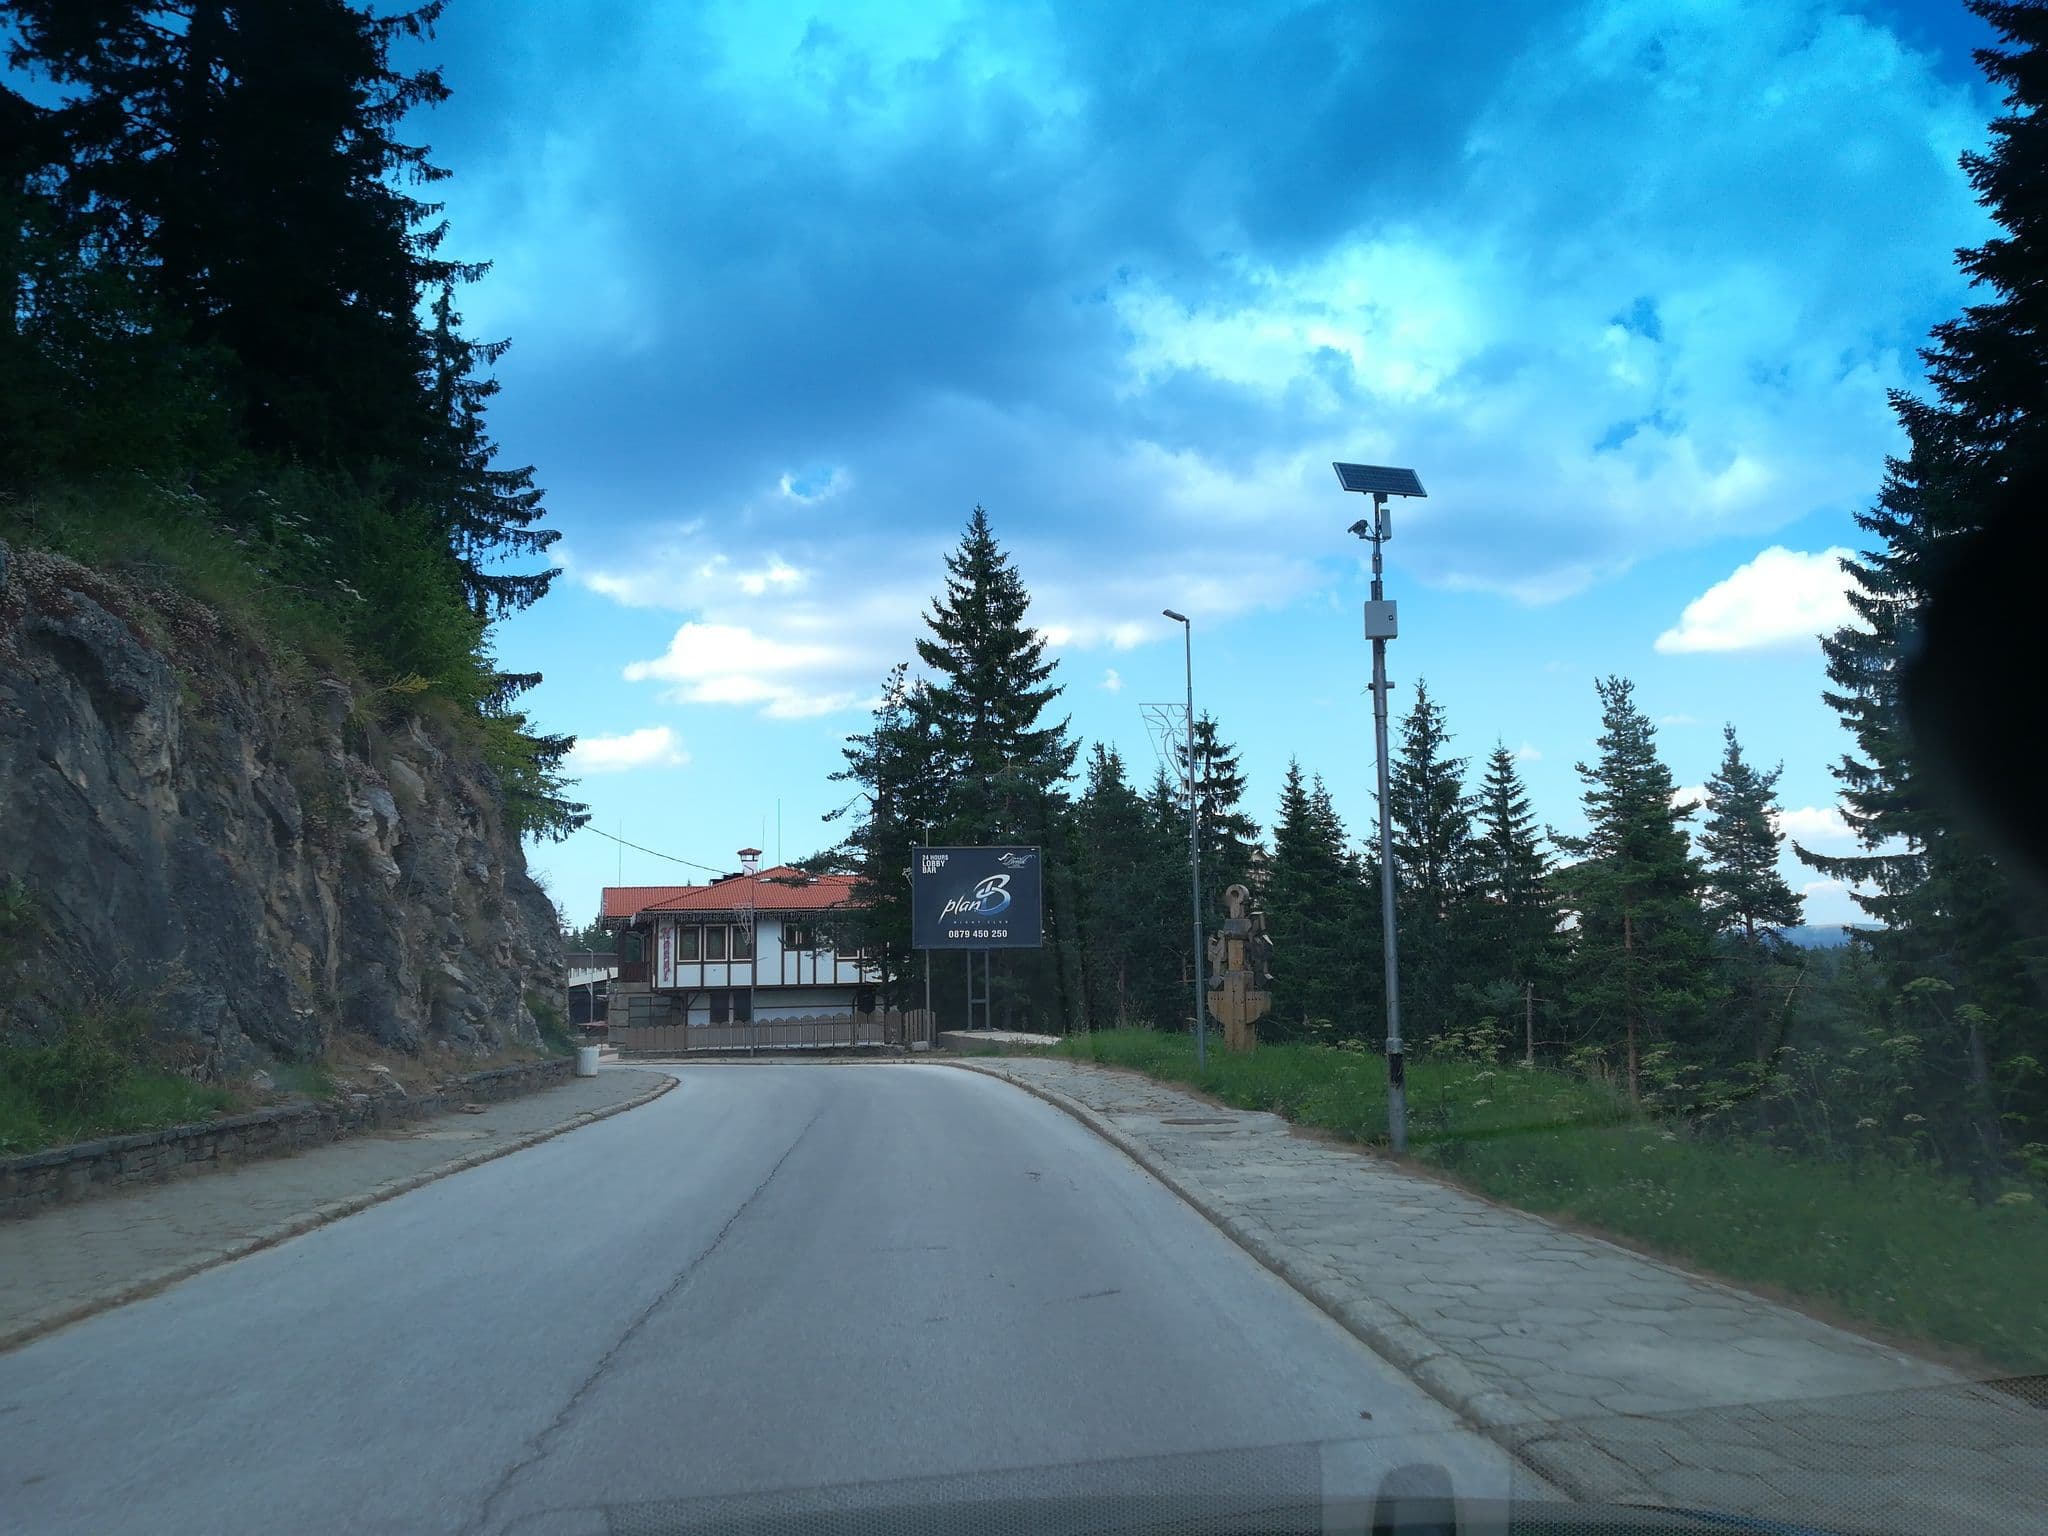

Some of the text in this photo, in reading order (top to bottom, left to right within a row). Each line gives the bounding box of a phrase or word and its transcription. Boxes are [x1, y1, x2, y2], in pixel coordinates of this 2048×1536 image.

[922, 866, 937, 874] BAR
[938, 874, 1011, 924] plan B
[948, 929, 1008, 938] 0879 450 250
